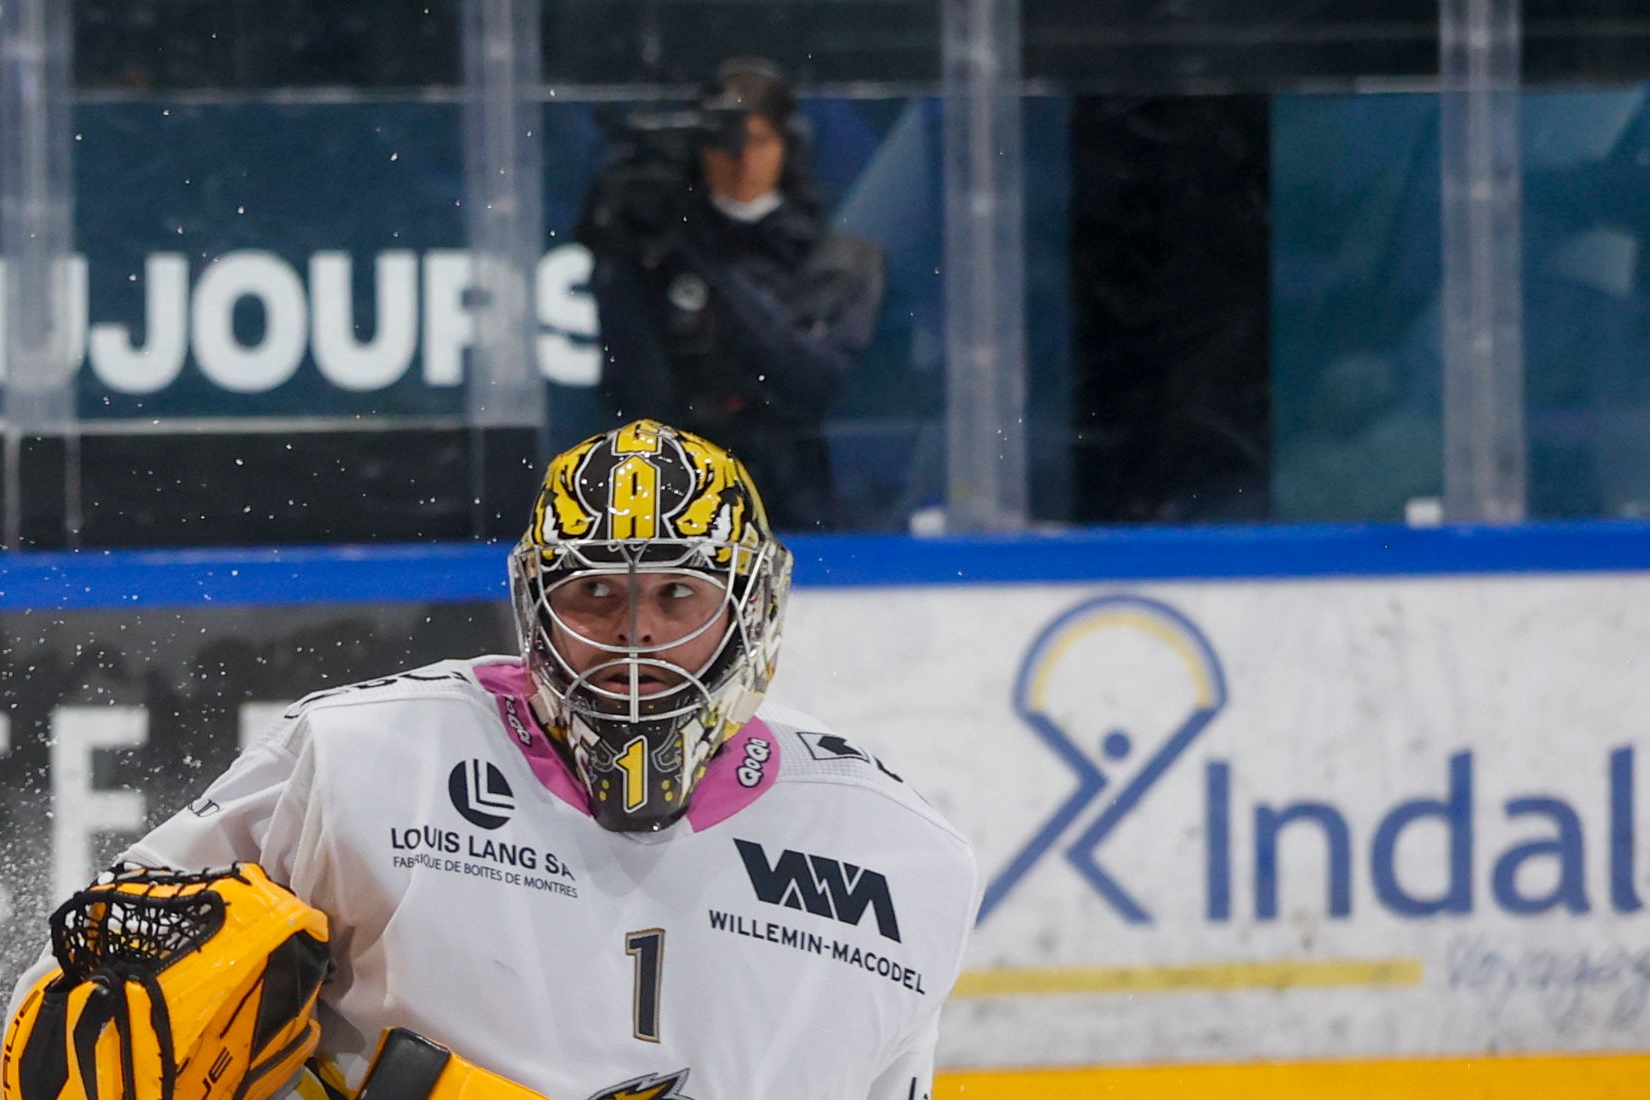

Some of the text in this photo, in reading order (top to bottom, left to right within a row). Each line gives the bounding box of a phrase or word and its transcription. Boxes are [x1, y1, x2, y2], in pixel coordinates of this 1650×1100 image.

[614, 736, 648, 813] 1
[390, 826, 461, 853] LOUIS
[467, 834, 538, 870] LANG
[443, 859, 462, 873] DE
[464, 863, 504, 884] BOITES
[504, 871, 522, 888] DE
[523, 875, 580, 900] MONTRES
[625, 928, 667, 1044] 1
[708, 908, 927, 996] WILLEMIN-MACODEL
